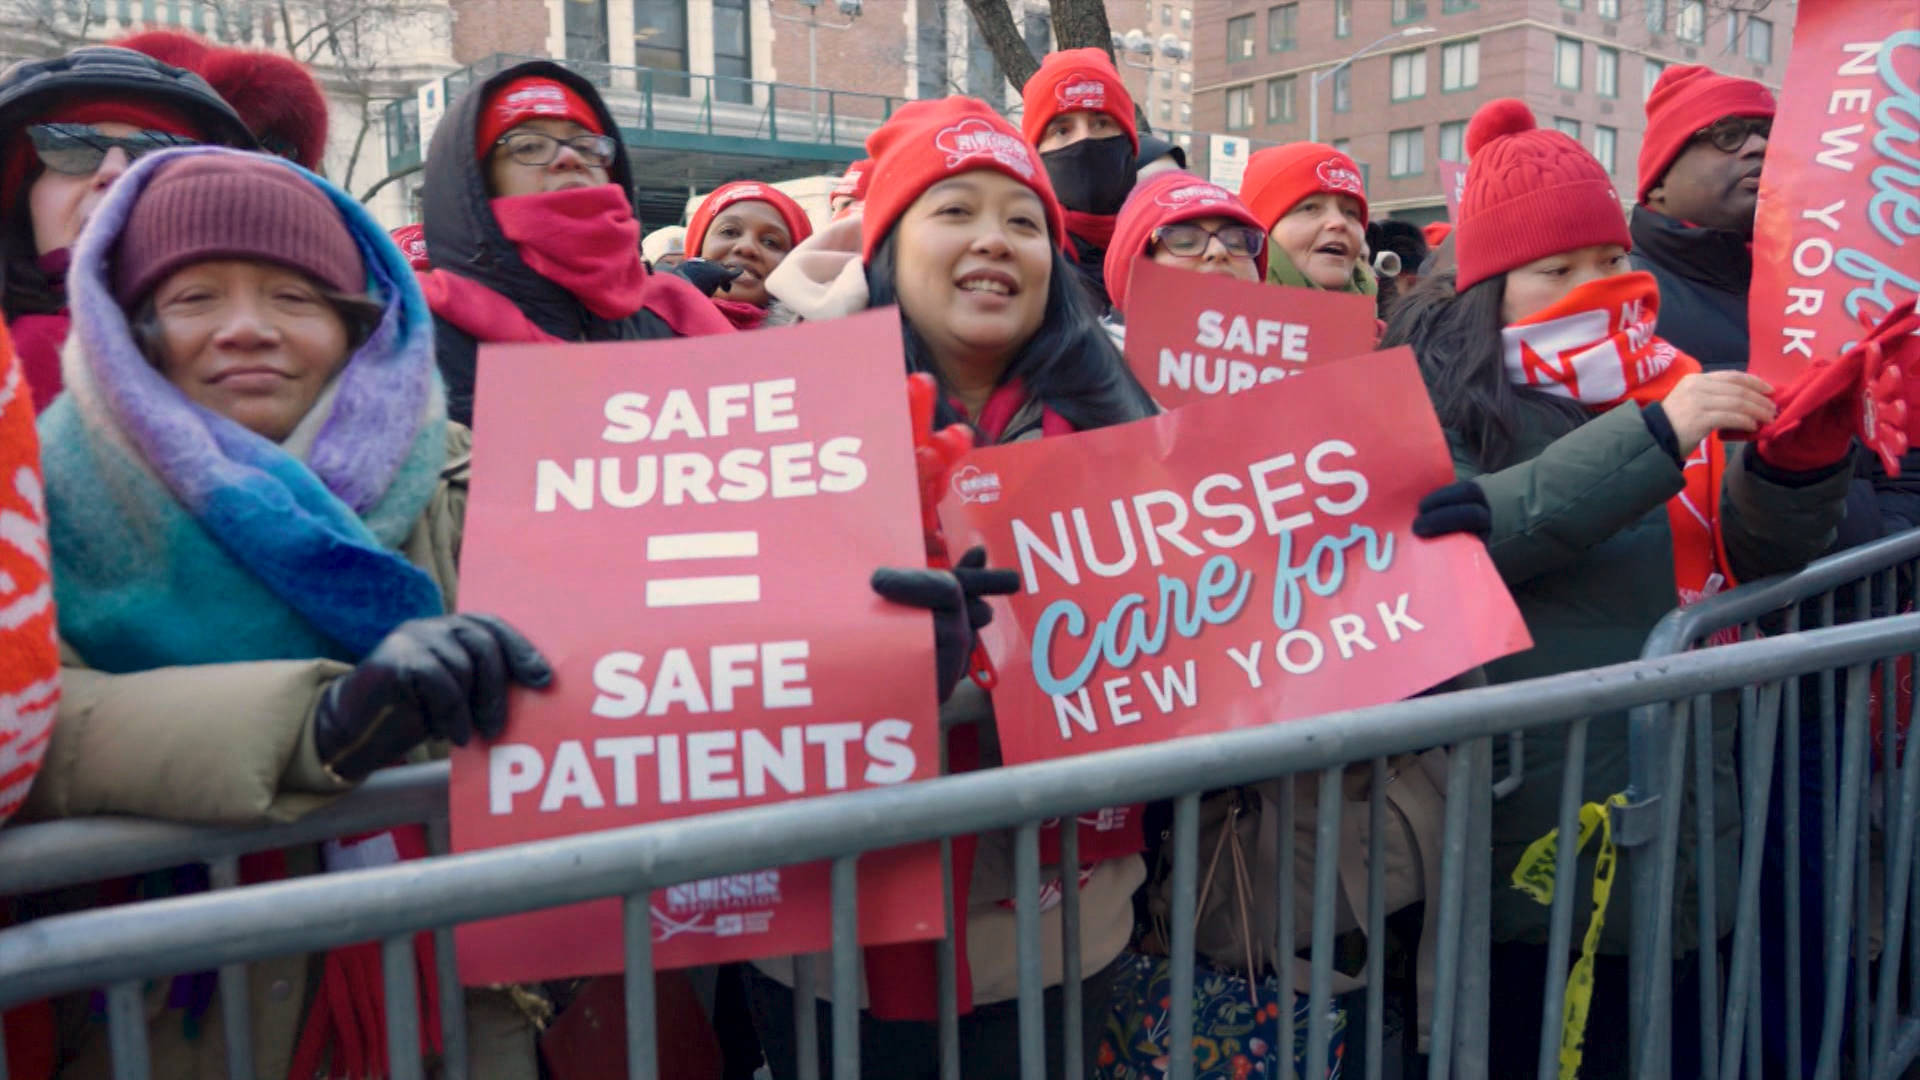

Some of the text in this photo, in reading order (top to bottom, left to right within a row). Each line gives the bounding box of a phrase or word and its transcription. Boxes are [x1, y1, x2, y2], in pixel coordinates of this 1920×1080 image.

[1781, 41, 1883, 359] NEW YORK
[1158, 348, 1304, 395] NUR
[1196, 310, 1310, 362] SAFE
[601, 378, 799, 443] SAFE
[535, 436, 868, 512] NURSES
[1011, 440, 1370, 594] NURSES
[1031, 523, 1395, 697] Care for
[591, 640, 814, 719] SAFE
[1051, 593, 1425, 740] NEW YORK
[489, 718, 917, 815] PATIENTS
